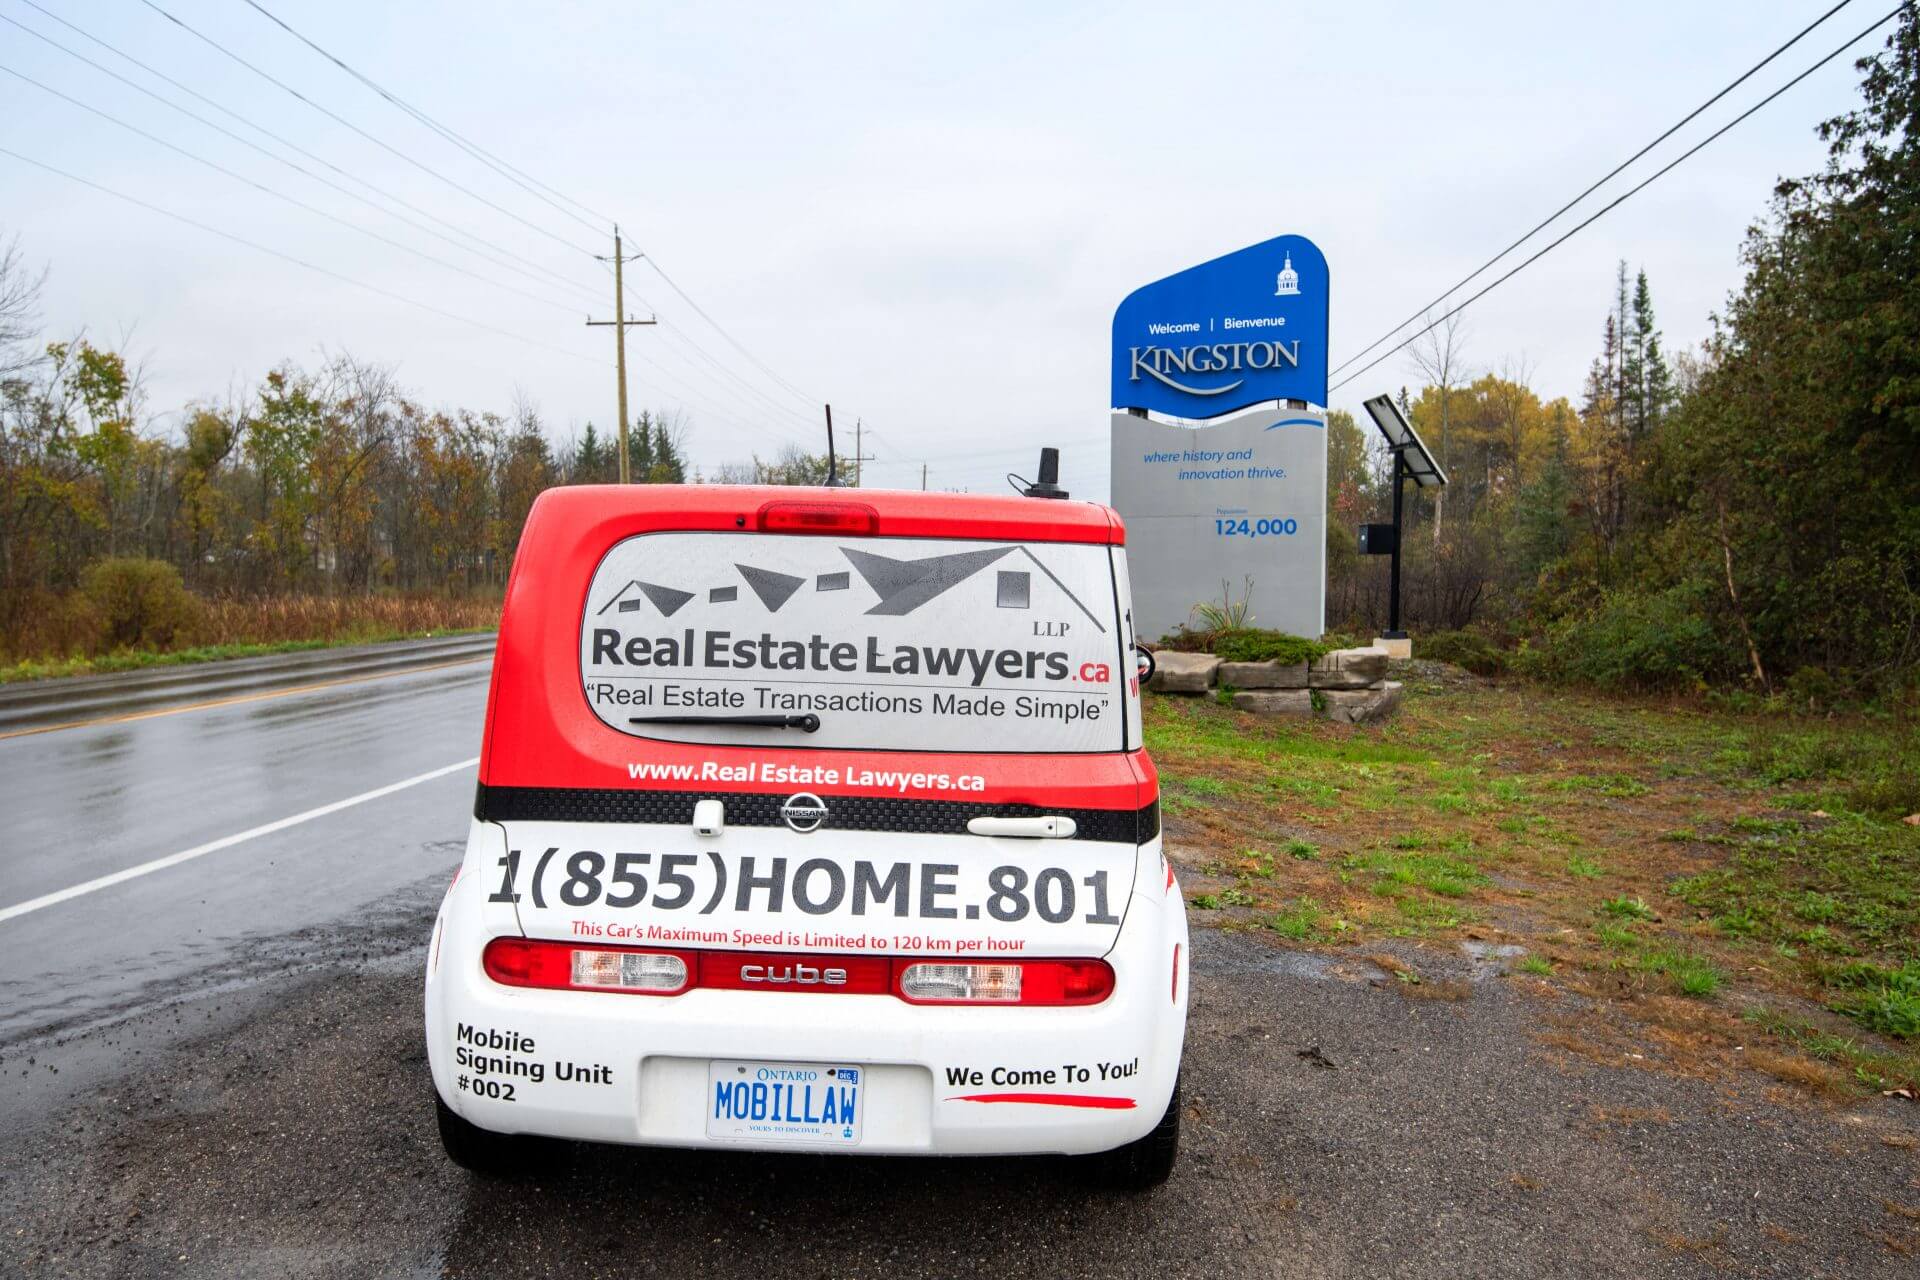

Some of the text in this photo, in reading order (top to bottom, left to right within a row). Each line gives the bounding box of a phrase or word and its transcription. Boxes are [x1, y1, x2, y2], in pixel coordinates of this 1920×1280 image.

[1149, 317, 1286, 335] Welcome Bienvenue
[1129, 340, 1301, 395] KINGSTON
[1144, 449, 1252, 463] where history and
[1179, 467, 1287, 480] innovation thrive.
[1215, 518, 1298, 538] 124,000
[1033, 621, 1070, 637] LLP
[663, 685, 745, 708] Estate
[753, 687, 922, 714] Transactions
[932, 693, 1005, 716] Made
[1015, 696, 1109, 724] Simple”
[627, 761, 985, 792] www.Real Estate Lawyers.ca
[572, 920, 1026, 953] This Car’s Maximum Speed is Limited to 120 km per hour
[740, 962, 847, 985] cube
[456, 1046, 613, 1085] Signing Unit
[757, 1068, 818, 1081] ONTARIO
[945, 1057, 1138, 1086] We Come To You!
[457, 1073, 517, 1102] #002
[715, 1081, 857, 1125] MOBILLAW
